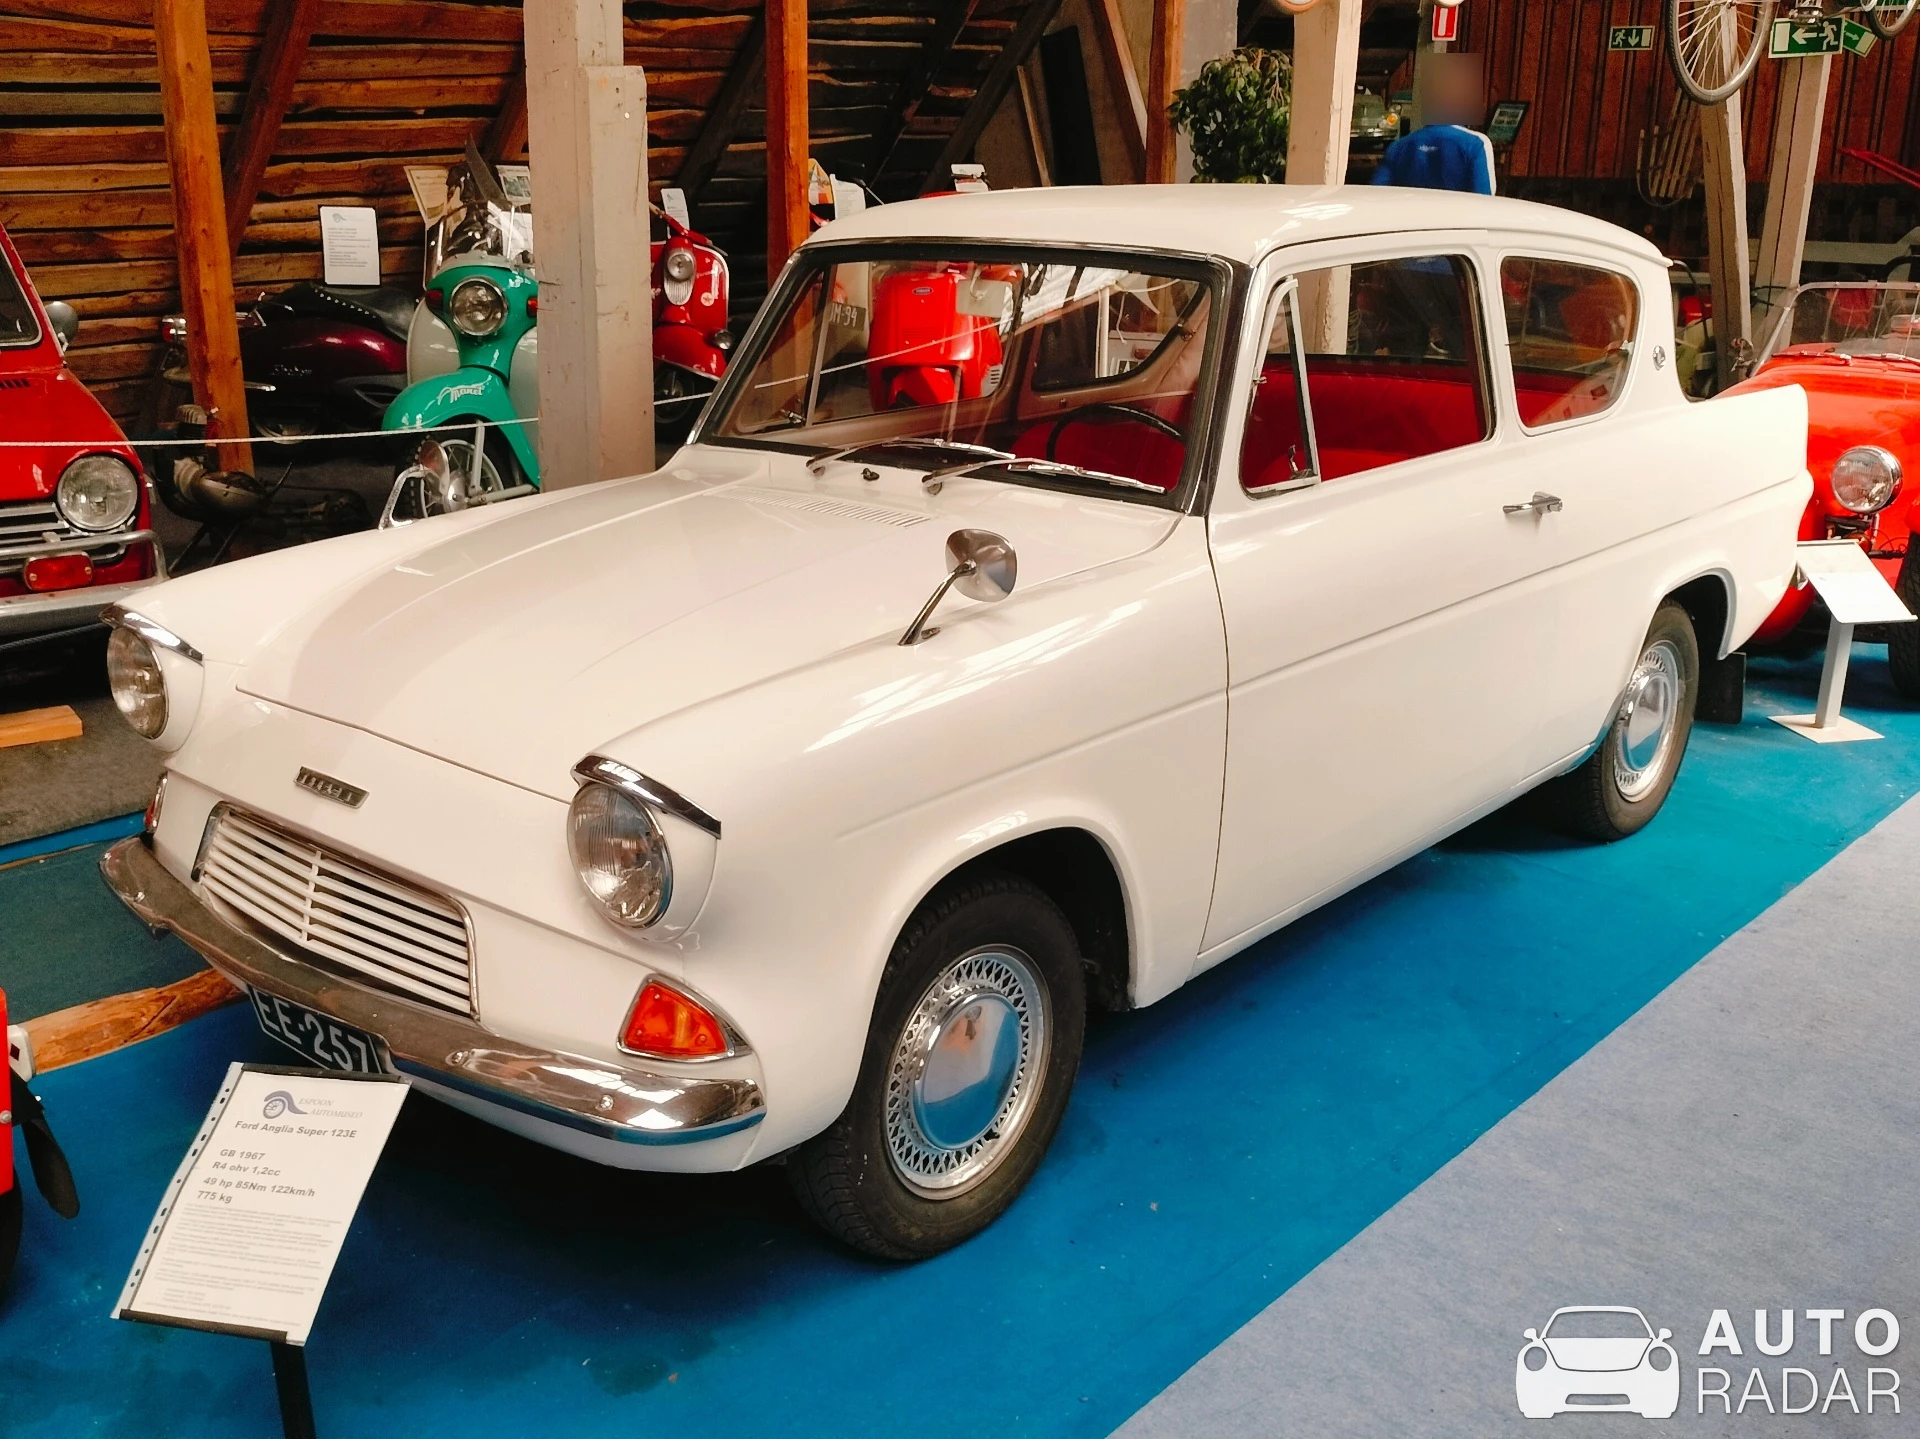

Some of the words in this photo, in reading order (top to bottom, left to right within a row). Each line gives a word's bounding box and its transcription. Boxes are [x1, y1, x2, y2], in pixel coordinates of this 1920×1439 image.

[298, 1097, 334, 1107] ESPOON
[309, 1108, 363, 1119] AUTOMUSEO
[234, 1120, 259, 1131] Ford
[261, 1123, 294, 1135] Anglia
[296, 1126, 328, 1137] Super
[331, 1128, 358, 1138] 123E
[220, 1149, 236, 1159] GB
[239, 1150, 266, 1161] 1967
[212, 1161, 227, 1171] R4
[229, 1163, 250, 1173] ohv
[252, 1166, 281, 1176] 1,2cc
[203, 1176, 217, 1186] 49
[218, 1178, 233, 1190] hp
[235, 1181, 267, 1192] 85Nm
[270, 1184, 316, 1197] 122km/h
[197, 1190, 216, 1201] 775
[218, 1192, 232, 1205] kg
